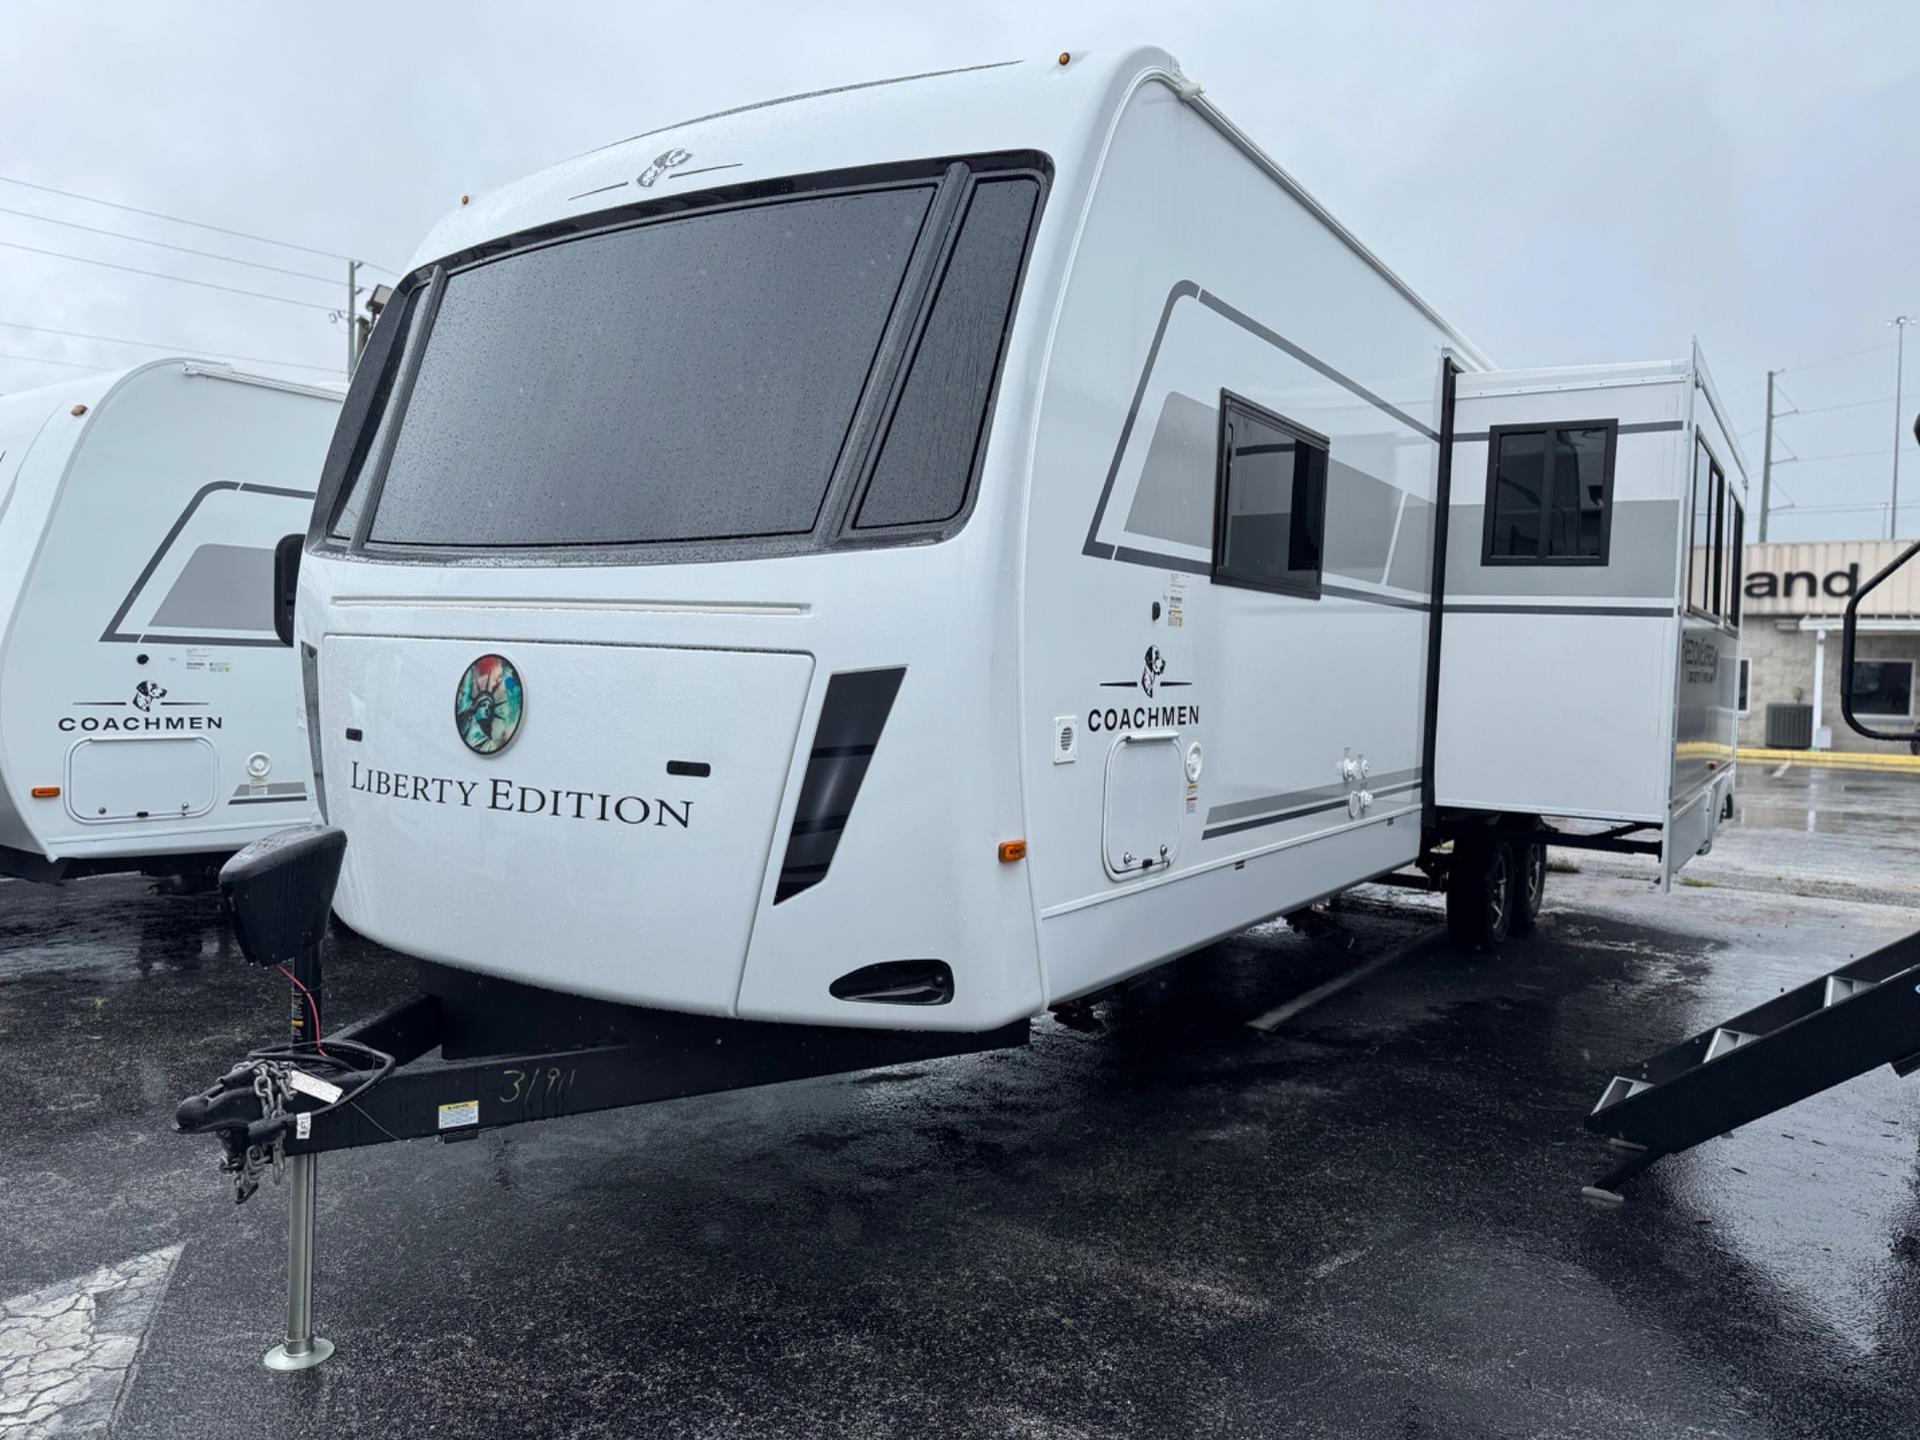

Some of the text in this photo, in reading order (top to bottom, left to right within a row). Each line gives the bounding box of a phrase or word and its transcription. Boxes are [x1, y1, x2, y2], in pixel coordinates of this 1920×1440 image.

[1744, 562, 1859, 598] and
[58, 716, 223, 732] COACHMEN
[1087, 705, 1200, 732] COACHMEN
[349, 760, 695, 829] LIBERTY EDITION
